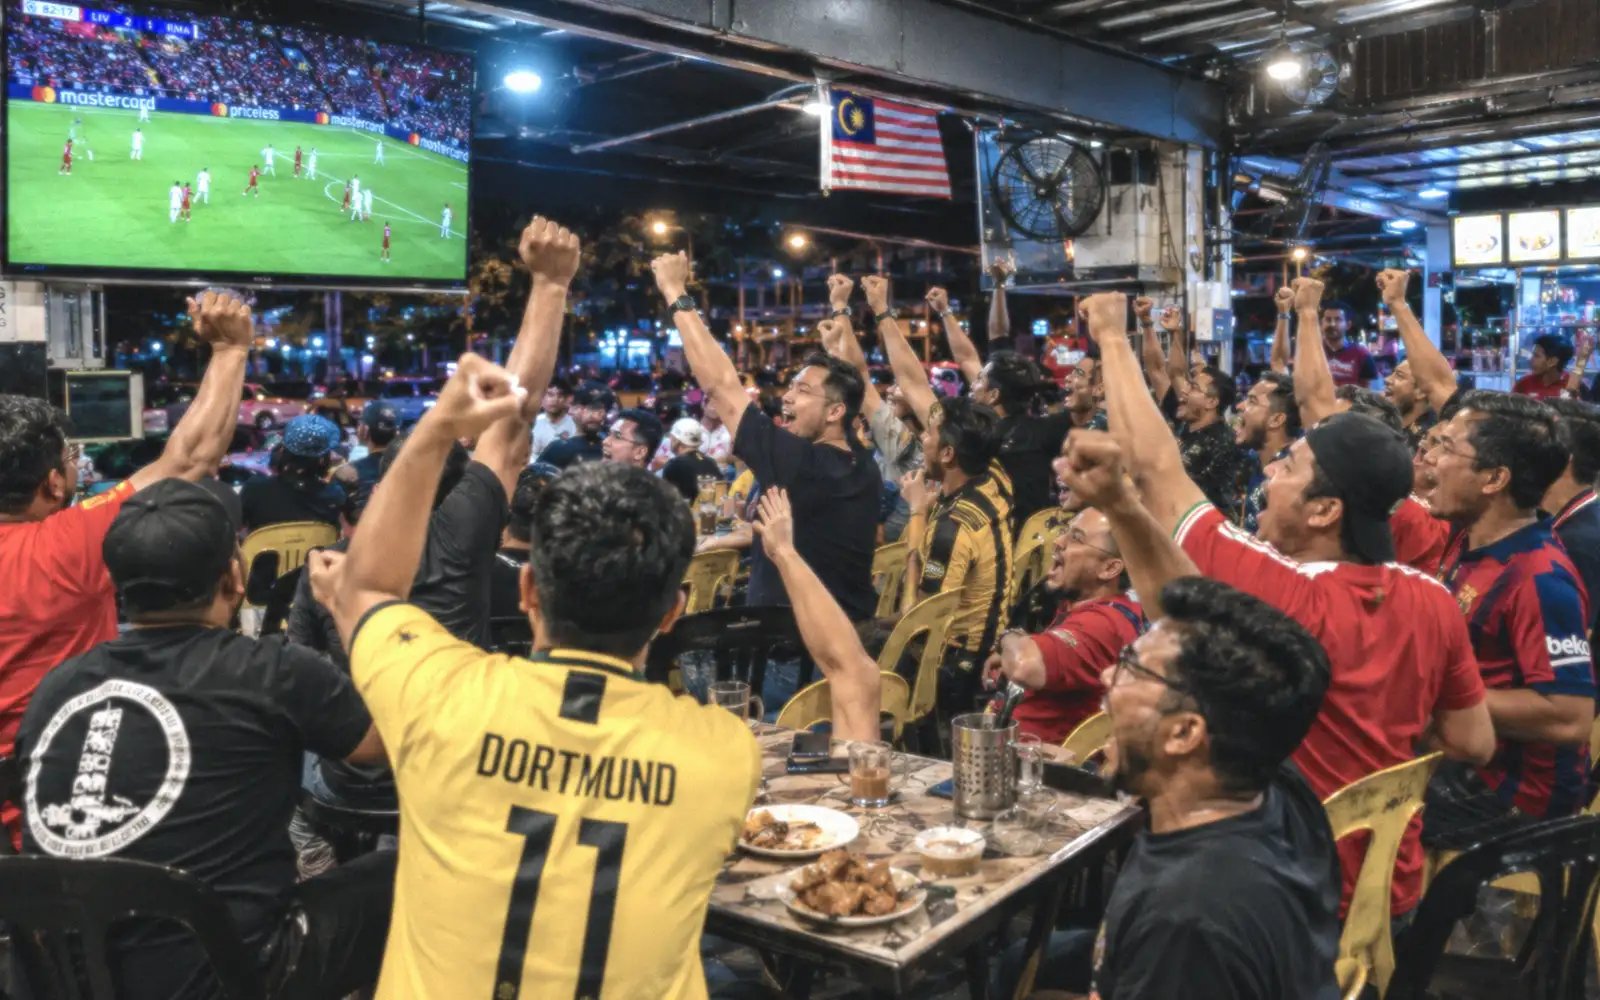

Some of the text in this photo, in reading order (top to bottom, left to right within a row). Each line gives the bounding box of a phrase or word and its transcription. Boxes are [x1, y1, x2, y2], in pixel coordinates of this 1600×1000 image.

[92, 12, 110, 24] LIV
[124, 17, 132, 26] 2
[167, 24, 190, 35] RMA
[60, 90, 155, 110] mastercard
[229, 105, 280, 120] priceless
[331, 116, 384, 133] mastercard
[1545, 634, 1591, 656] beko
[477, 732, 676, 806] DORTMUND
[493, 804, 629, 1000] 11
